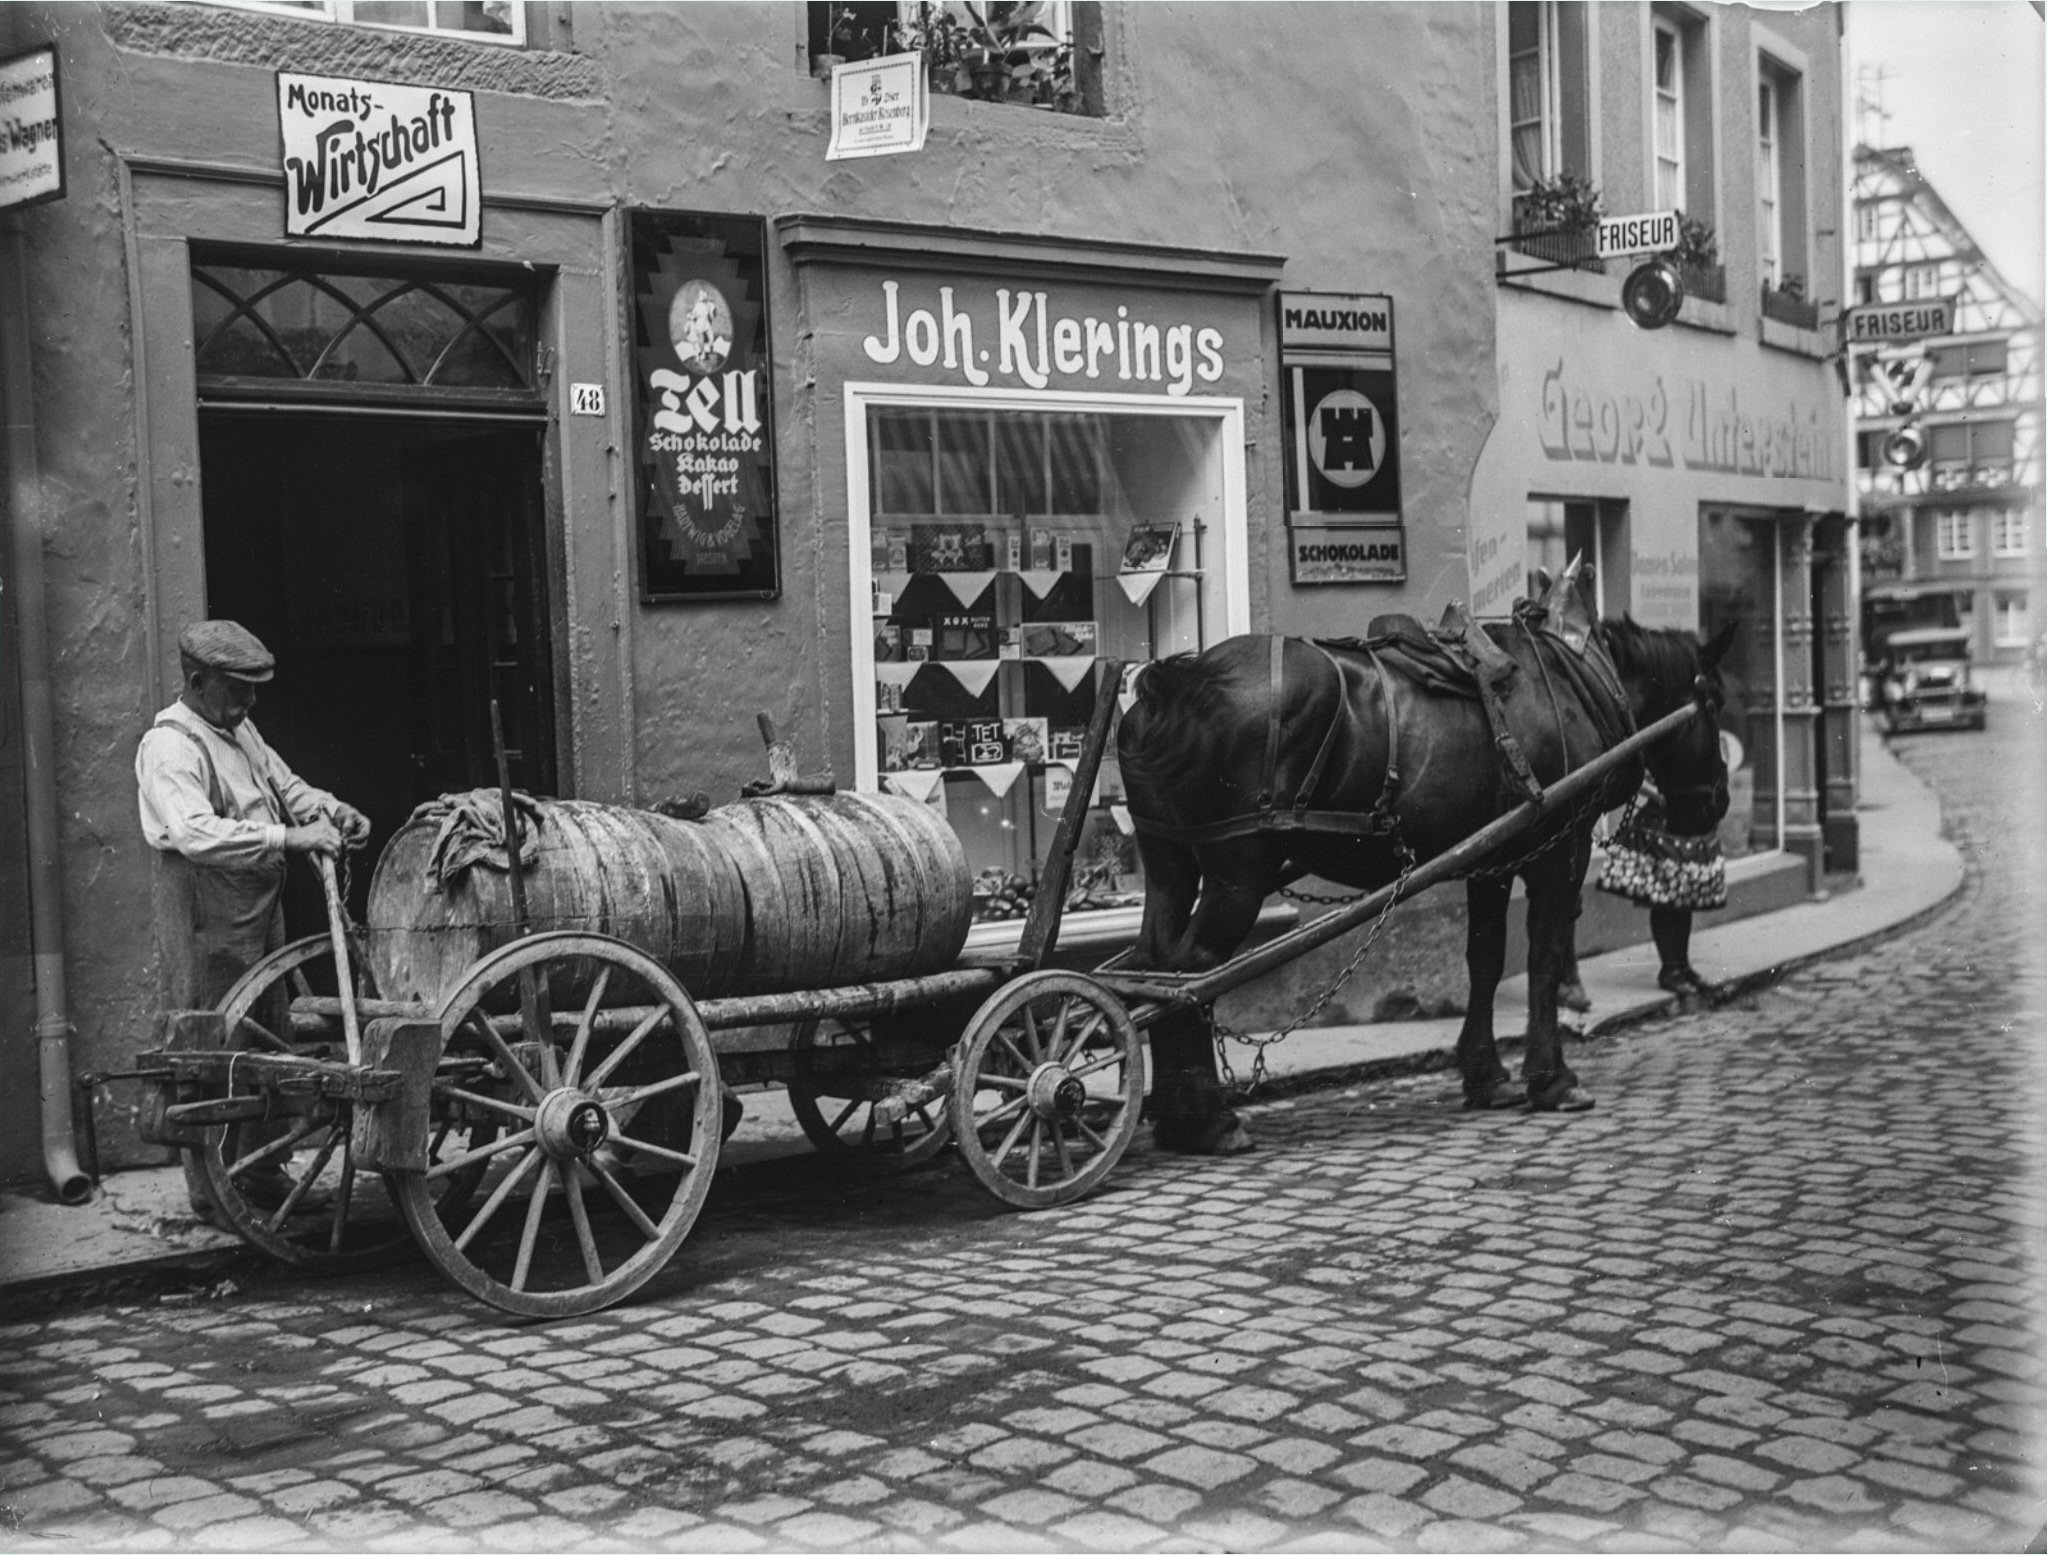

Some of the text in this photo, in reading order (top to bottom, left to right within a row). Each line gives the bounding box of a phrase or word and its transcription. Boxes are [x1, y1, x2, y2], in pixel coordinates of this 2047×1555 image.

[288, 84, 384, 121] Monats-
[286, 93, 455, 215] Wirtschaft
[1600, 217, 1675, 251] FRISEUR
[1285, 309, 1387, 332] MAUXION
[1854, 307, 1945, 336] FRISEUR
[863, 280, 1224, 396] Joh. Klerings
[576, 388, 600, 411] 48
[650, 368, 762, 435] Tell
[649, 432, 762, 452] Schokolade
[676, 452, 739, 473] Kakao
[678, 473, 739, 511] Dessert
[1299, 544, 1399, 563] SCHOKOLADE
[971, 723, 1001, 743] TET
